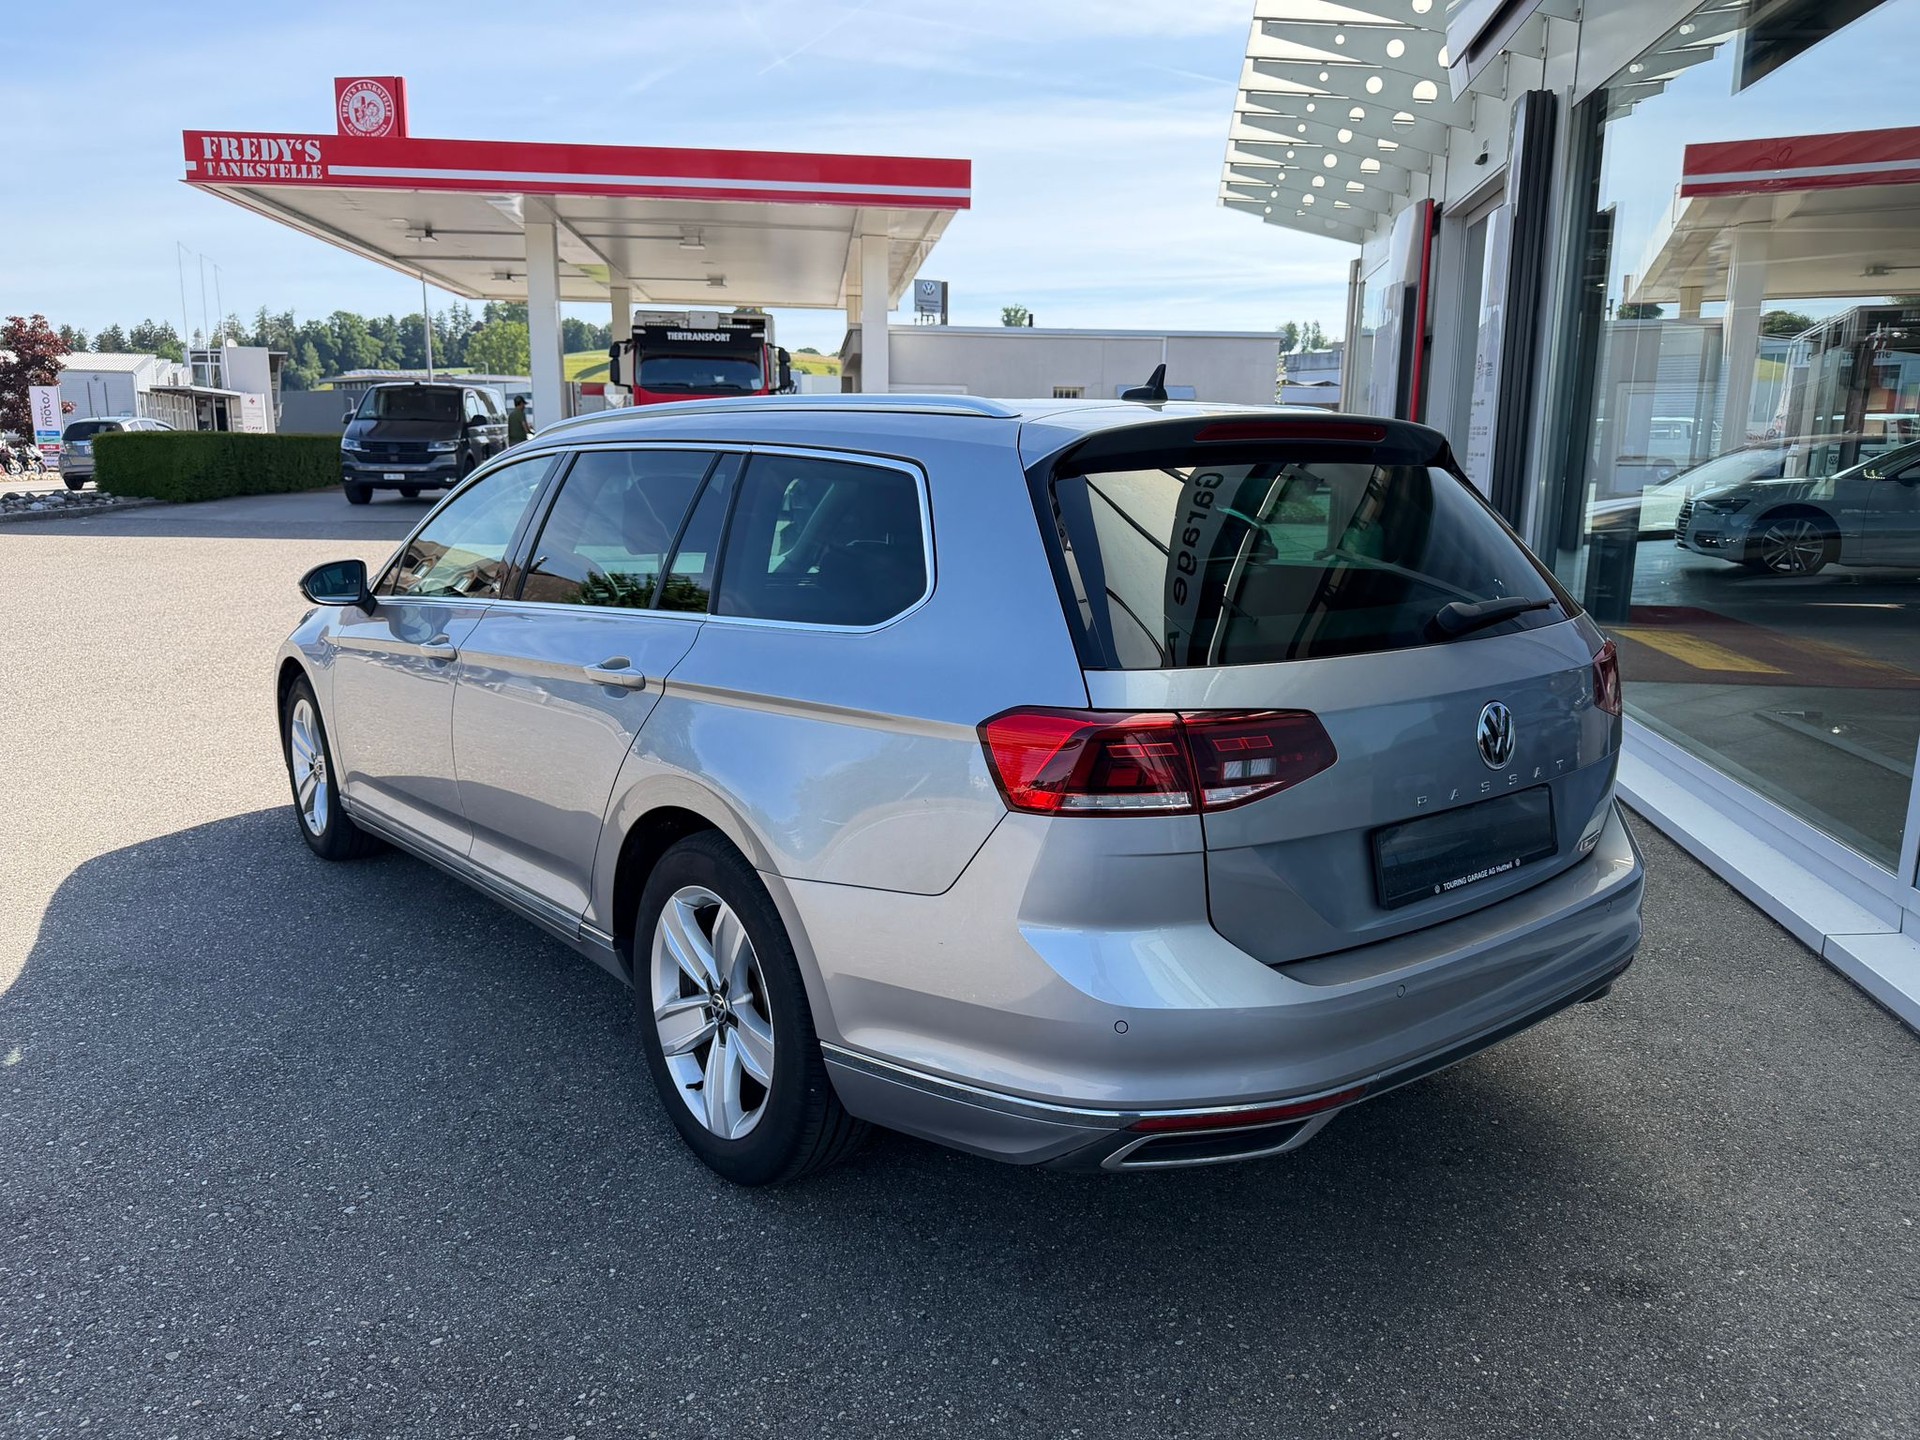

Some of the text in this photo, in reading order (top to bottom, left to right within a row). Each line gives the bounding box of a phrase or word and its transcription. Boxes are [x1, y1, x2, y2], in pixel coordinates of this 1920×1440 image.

[357, 83, 392, 117] TANKSTELLE
[201, 136, 322, 163] FREDY'S
[204, 161, 323, 179] TANKSTELLE
[666, 331, 731, 342] TIERTRANSPORT
[1416, 759, 1564, 807] PASSAT
[1443, 877, 1467, 891] TOURING
[1466, 869, 1488, 883] GARAGE
[1488, 867, 1496, 876] AG
